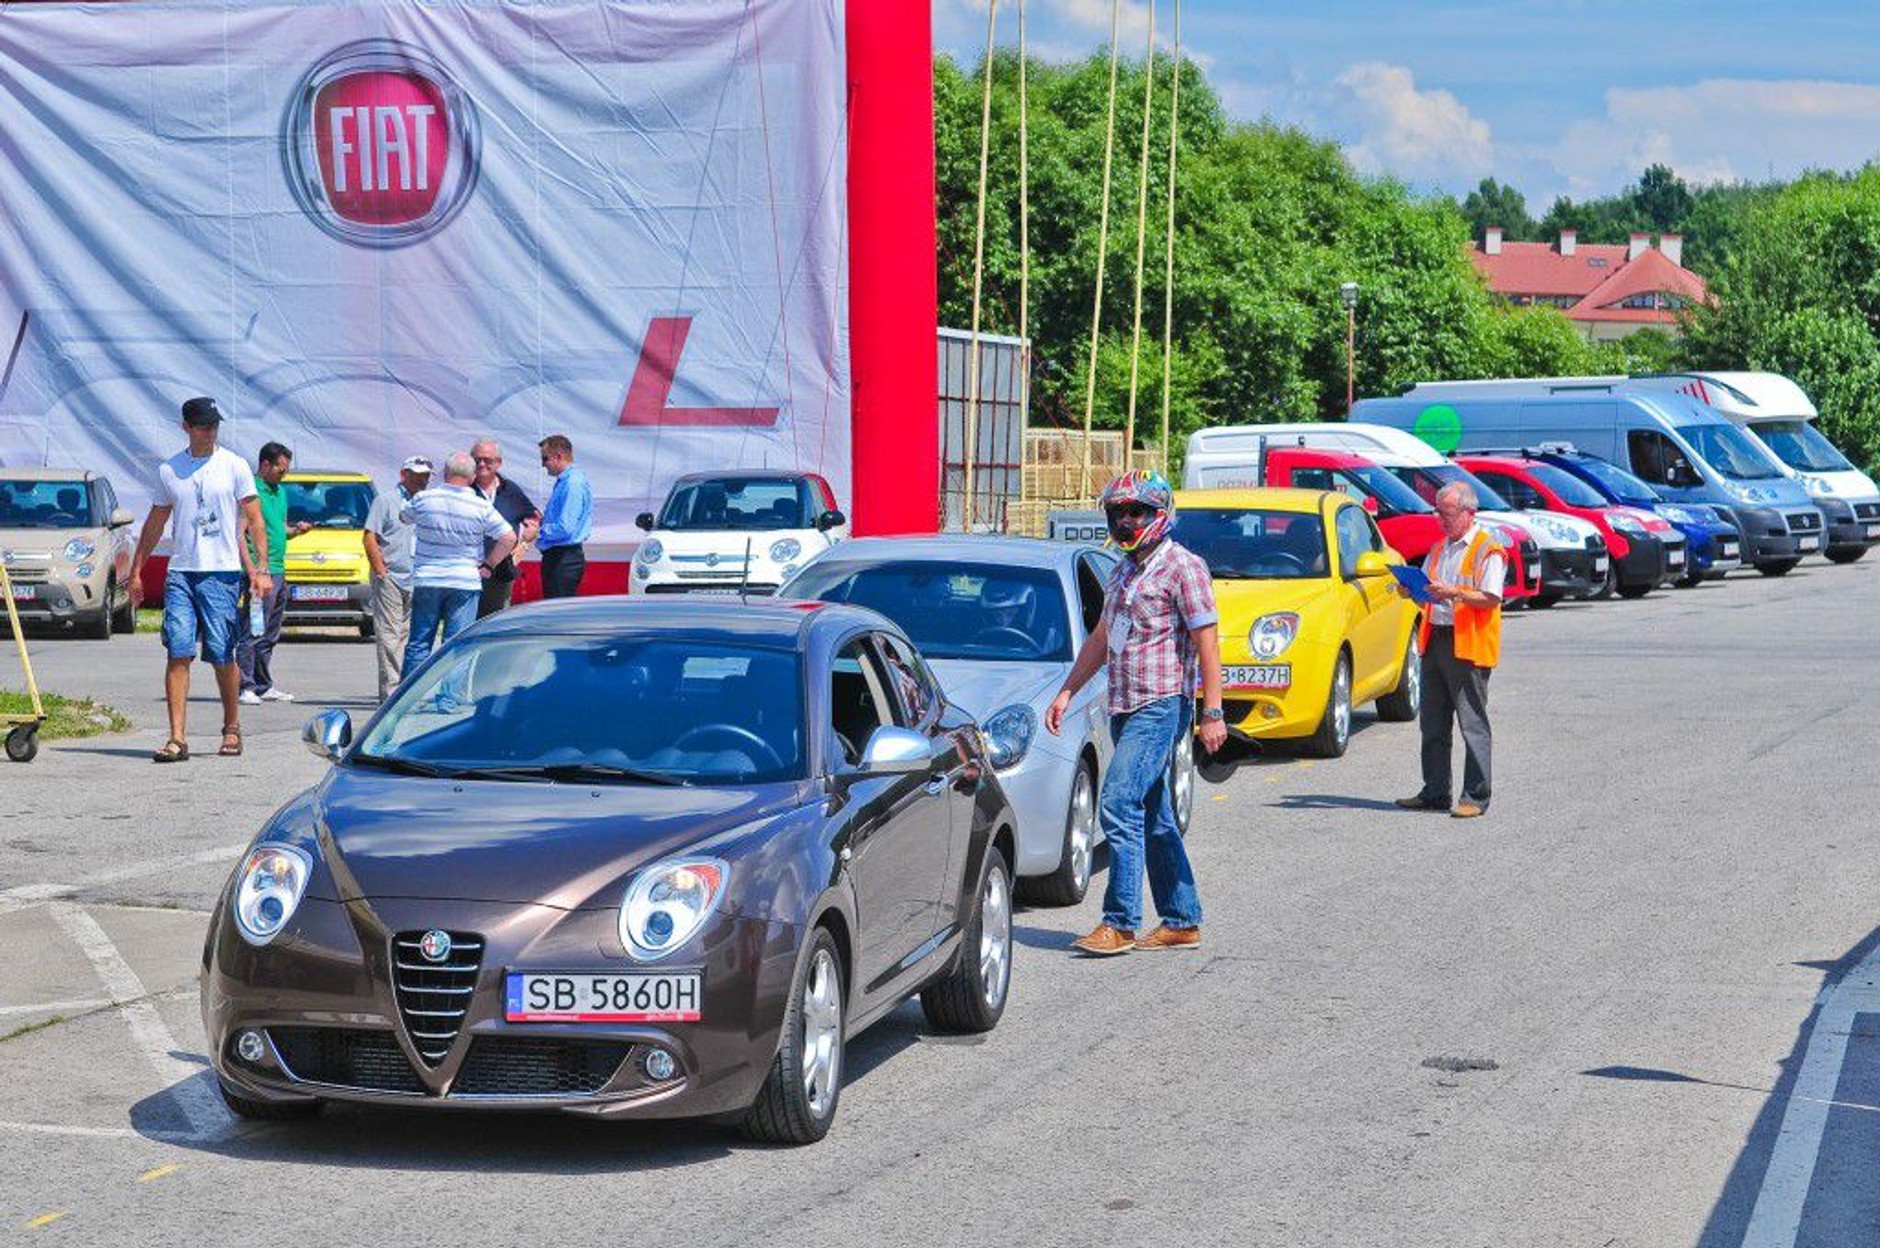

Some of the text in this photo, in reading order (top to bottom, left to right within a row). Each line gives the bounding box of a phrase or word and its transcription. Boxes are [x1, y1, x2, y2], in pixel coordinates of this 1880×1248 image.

[330, 104, 436, 191] FIAT
[1237, 668, 1288, 683] 8237H
[529, 978, 576, 1010] SB
[591, 978, 695, 1010] 5860H
